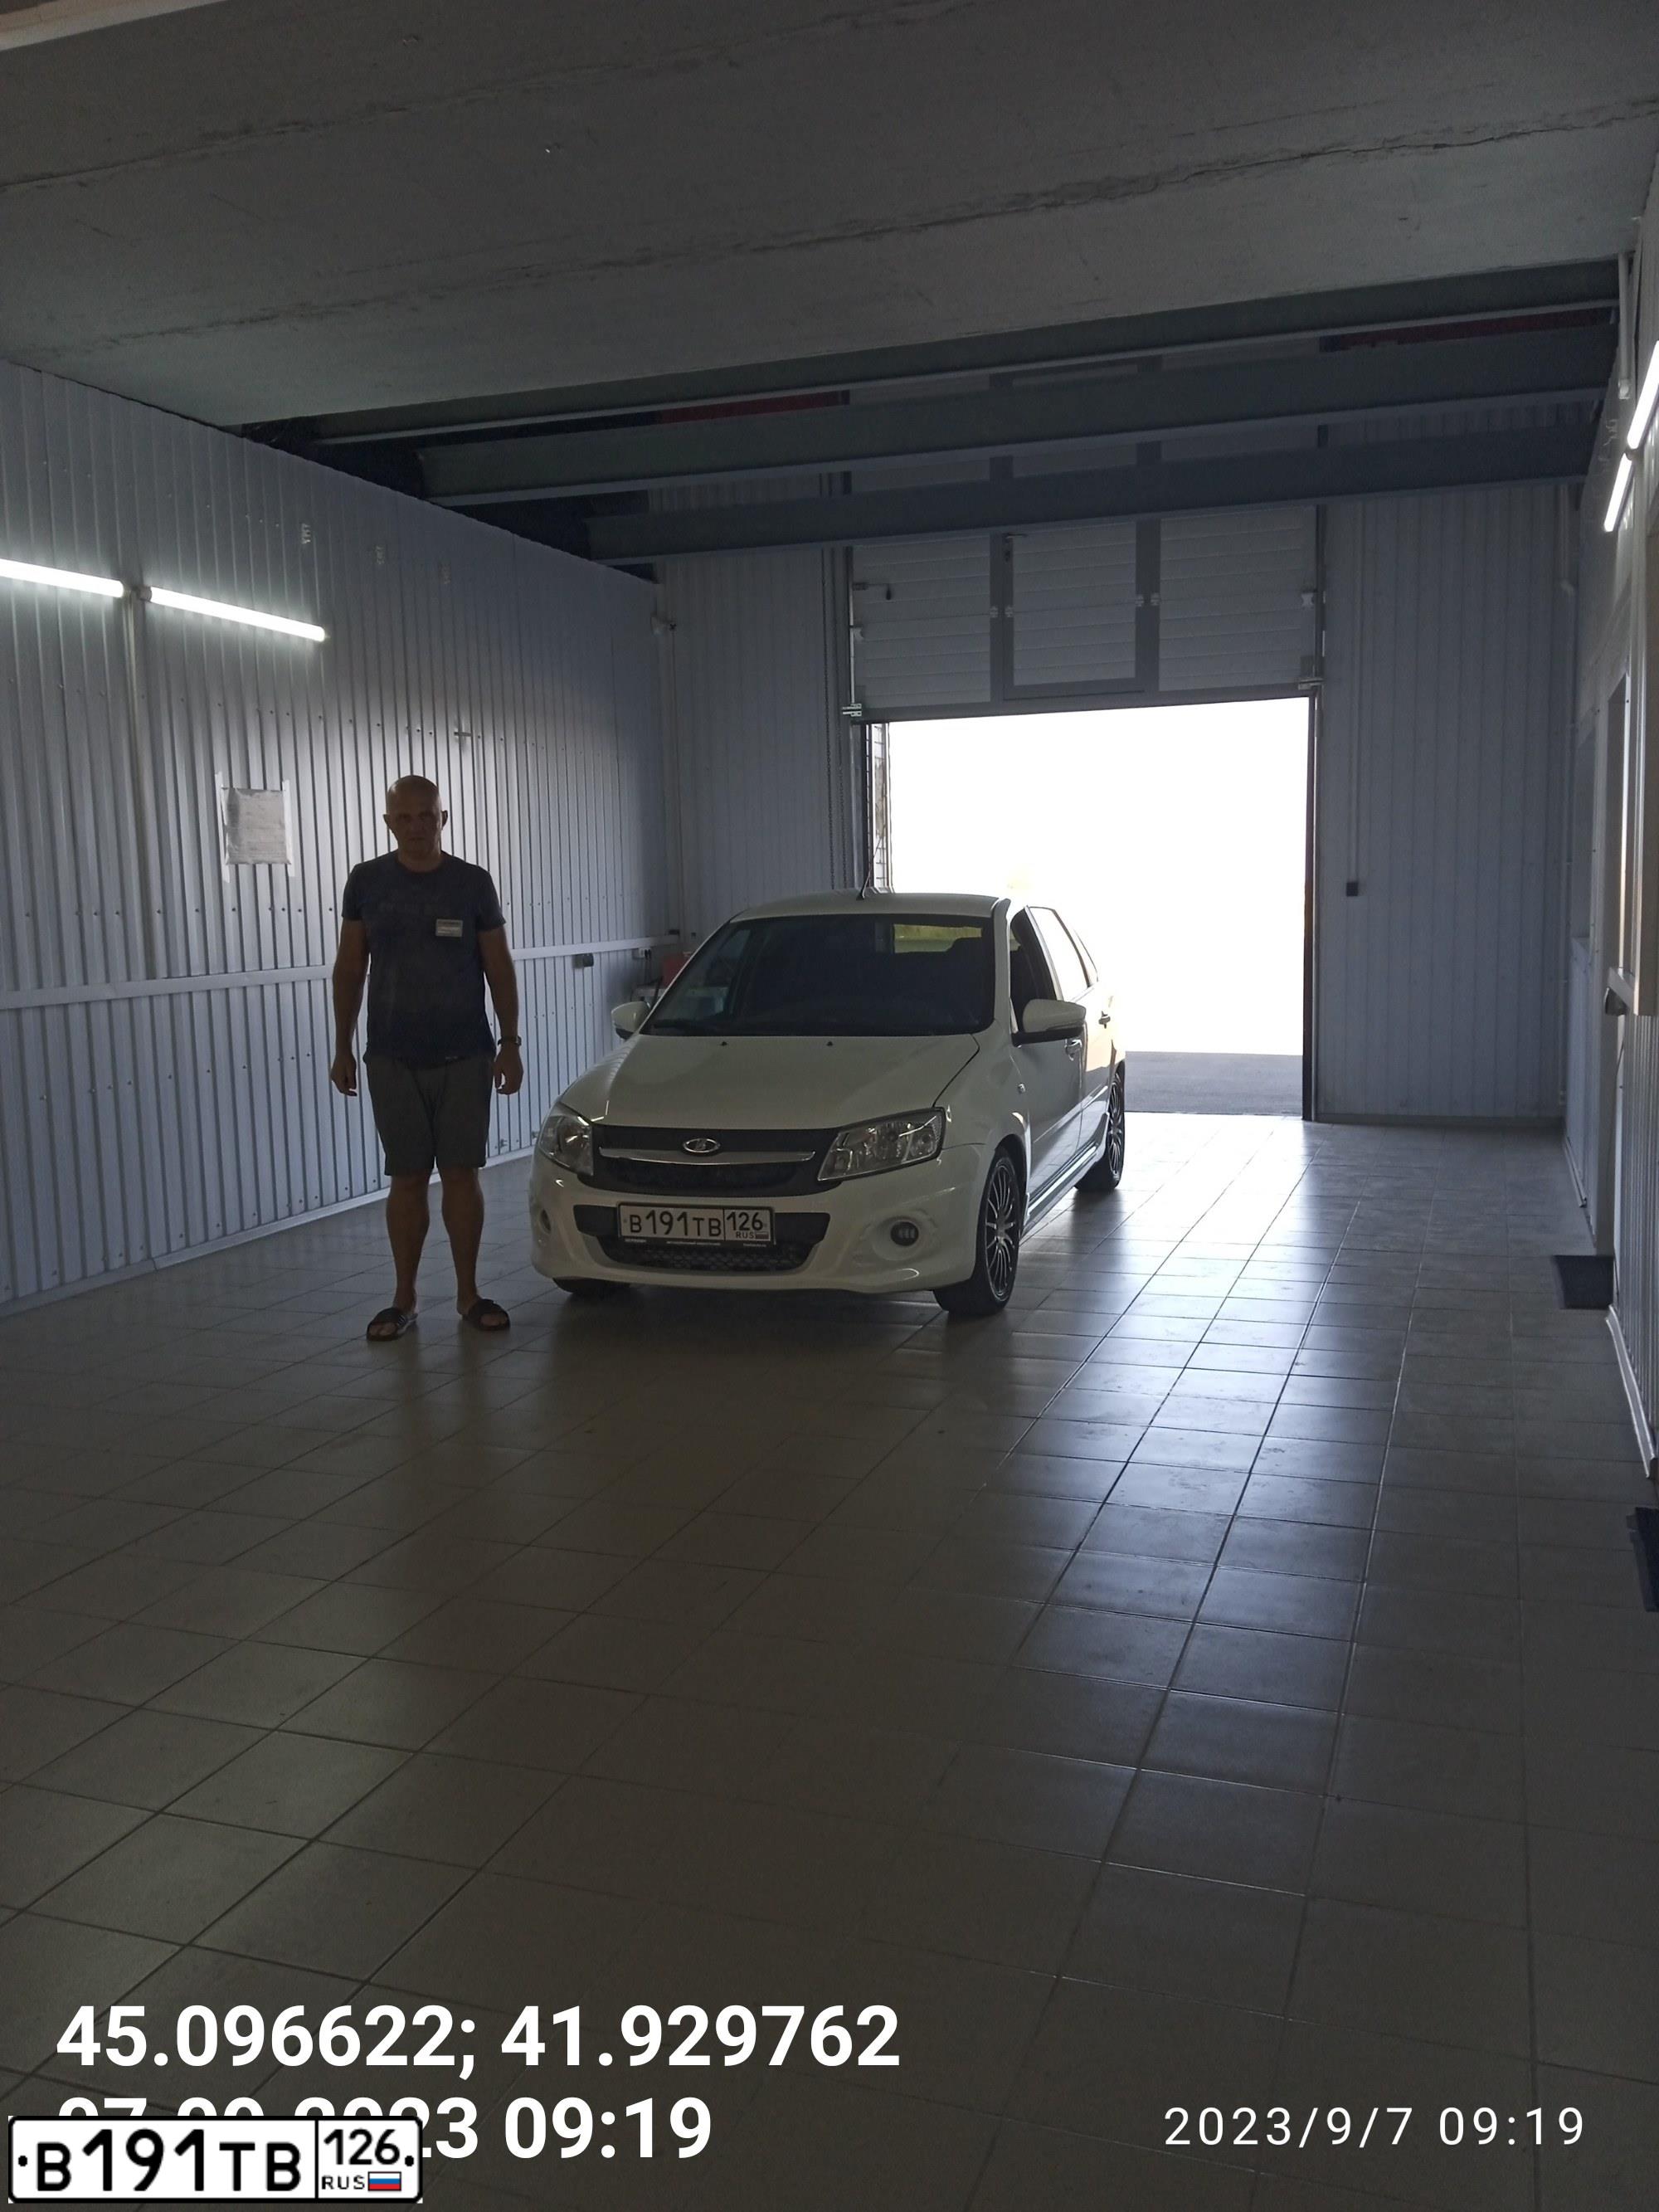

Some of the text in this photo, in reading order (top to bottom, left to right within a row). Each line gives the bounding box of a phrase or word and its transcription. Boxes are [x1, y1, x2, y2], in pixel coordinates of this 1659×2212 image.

[629, 1210, 763, 1237] В191ТВ 126
[736, 1231, 755, 1240] RUS
